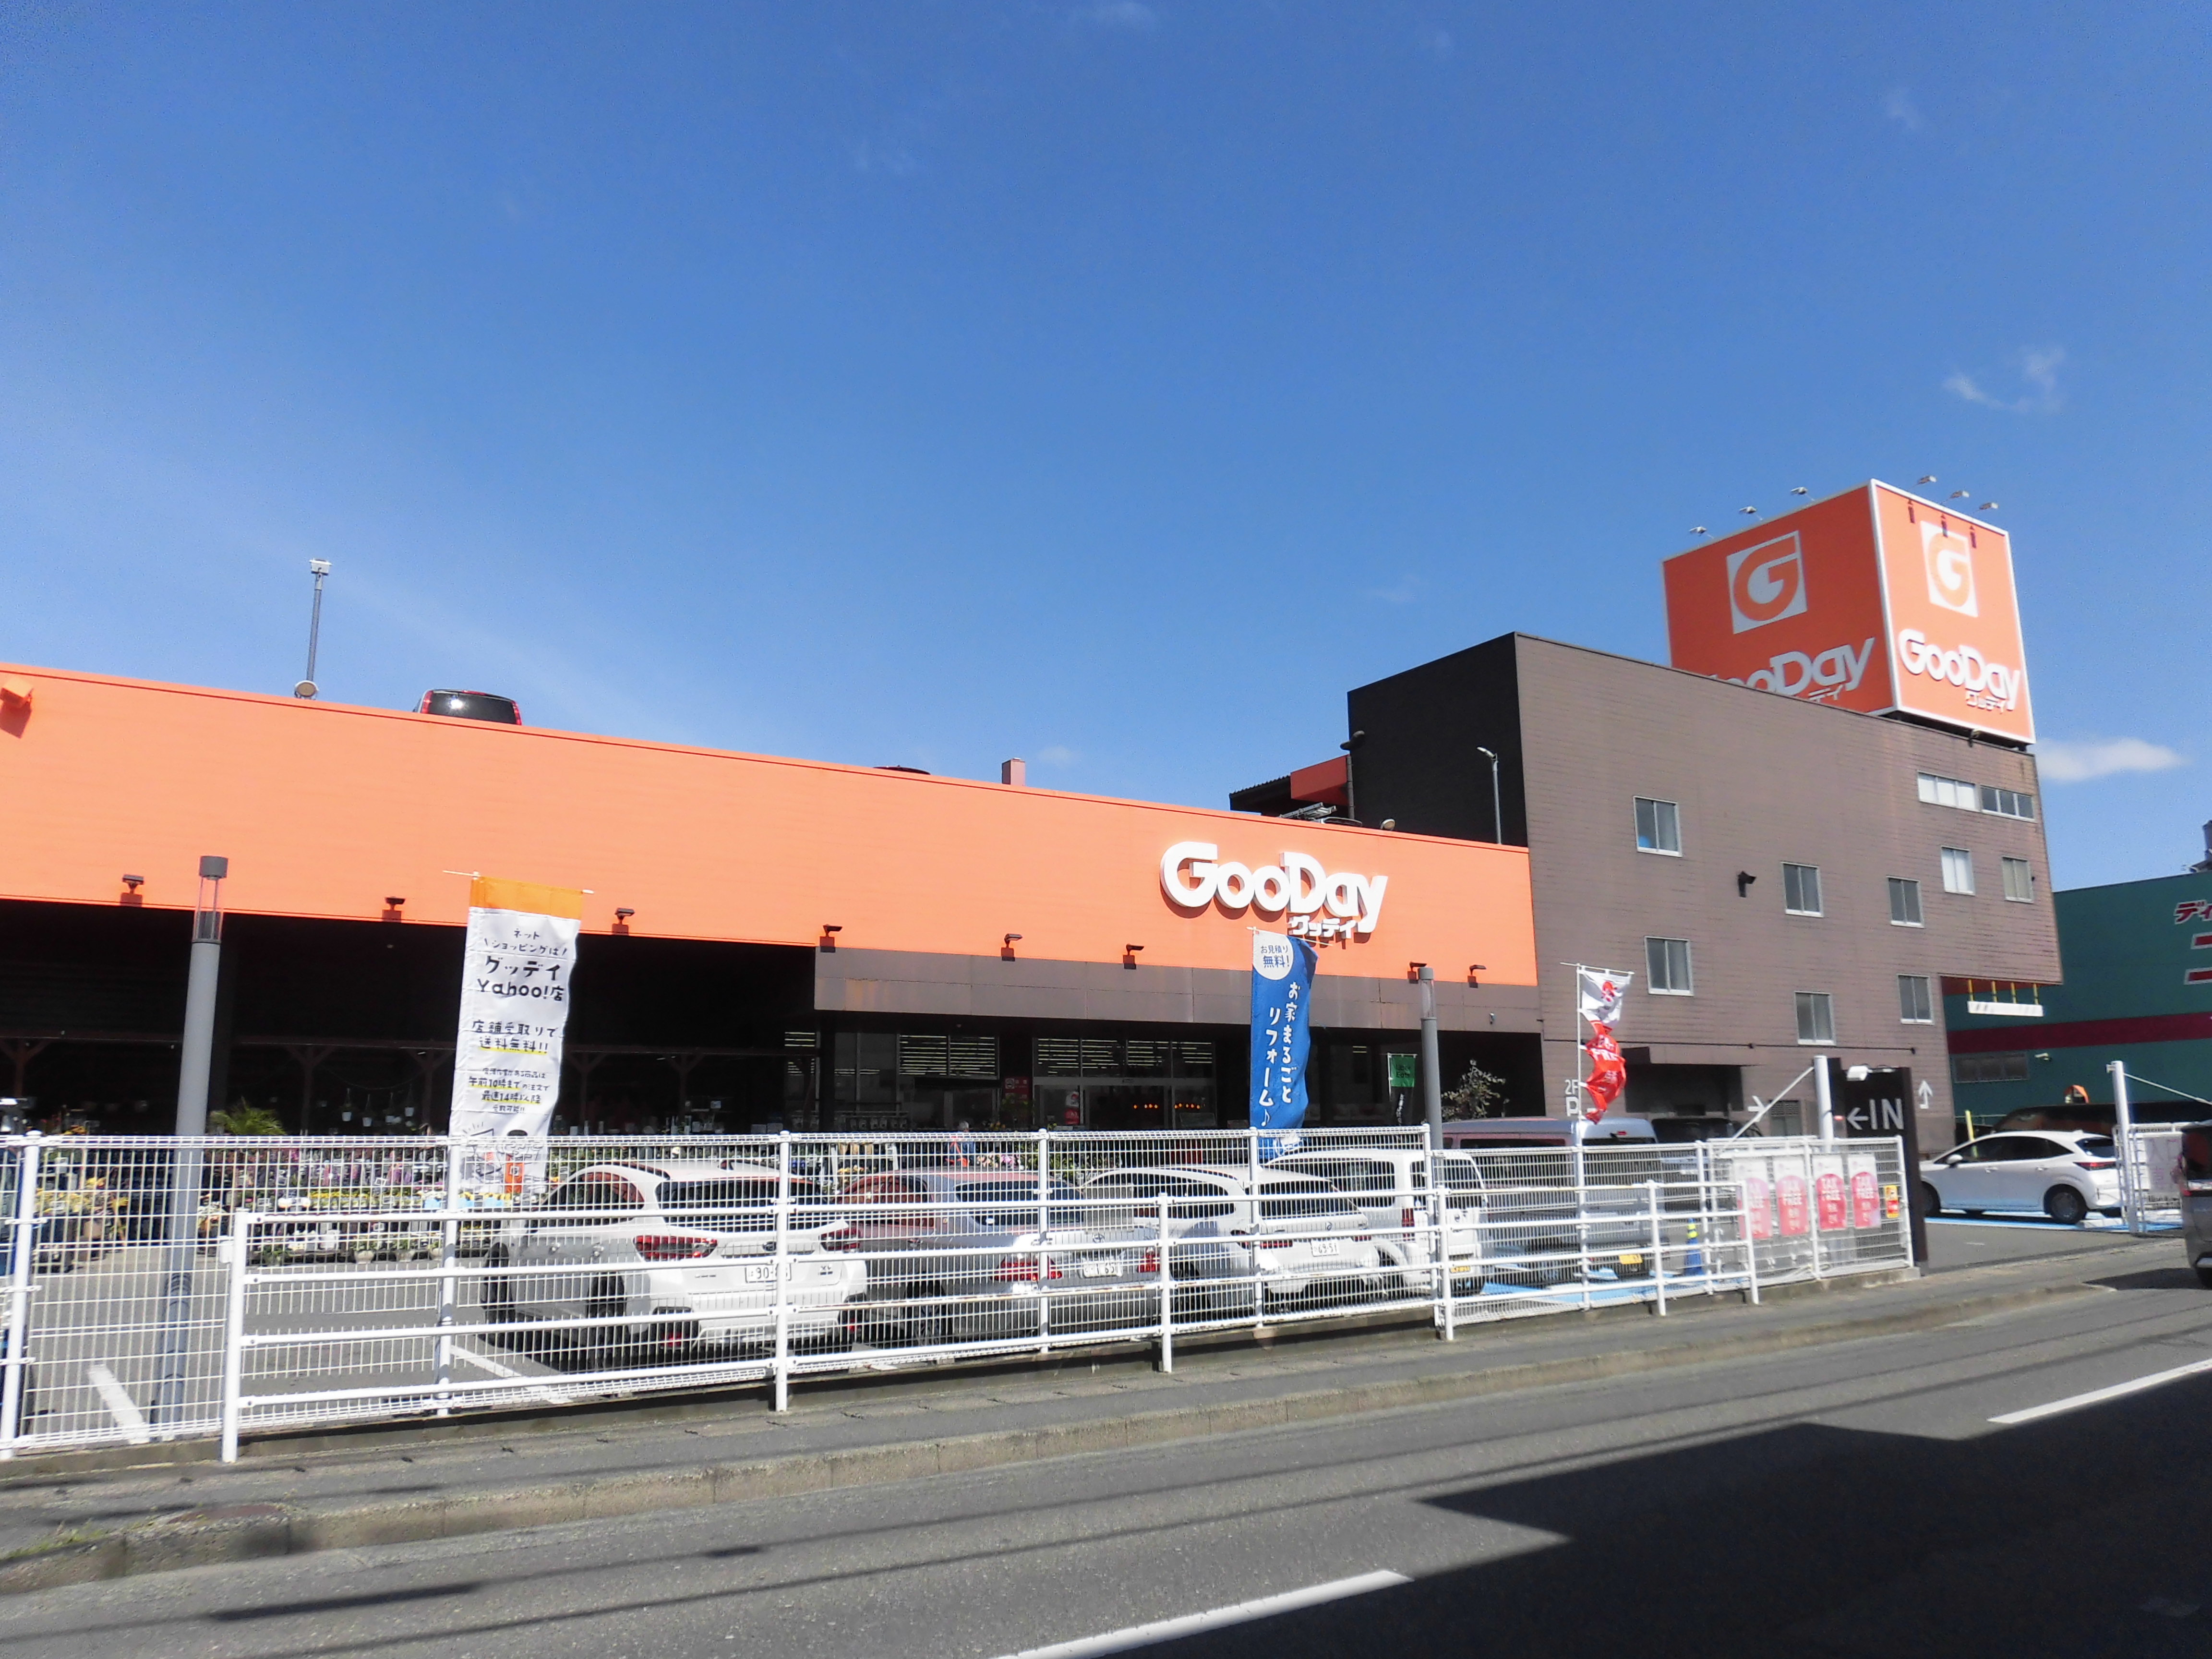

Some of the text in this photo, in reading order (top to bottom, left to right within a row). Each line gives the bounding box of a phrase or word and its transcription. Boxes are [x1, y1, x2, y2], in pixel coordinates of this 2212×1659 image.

[1899, 629, 2020, 710] GooDay
[1160, 842, 1388, 933] GooDay
[514, 928, 540, 939] ネット
[1260, 945, 1288, 954] お見積り
[1262, 954, 1290, 968] 無料!
[472, 1019, 558, 1037] 店舗受取りで
[1280, 982, 1302, 1104] お家まるごと
[1564, 1079, 1579, 1095] 2F
[1870, 1098, 1904, 1130] IN
